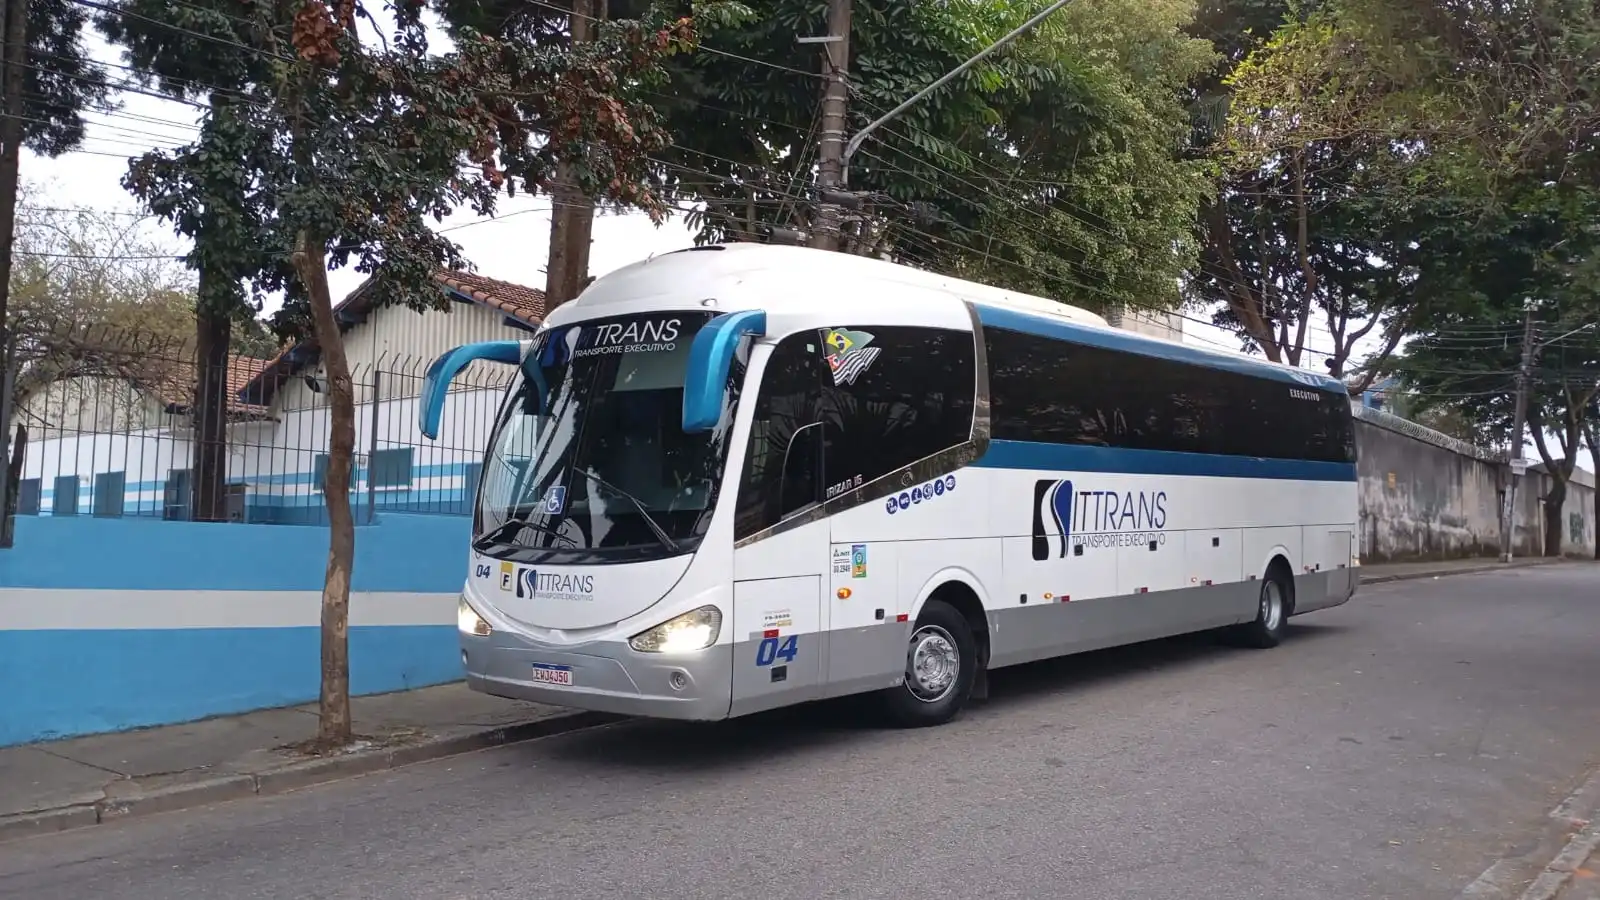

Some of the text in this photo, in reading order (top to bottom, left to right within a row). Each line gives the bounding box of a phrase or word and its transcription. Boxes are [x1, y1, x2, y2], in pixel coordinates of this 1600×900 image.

[575, 343, 676, 358] TRANSPORTE EXECUTIVO
[1289, 388, 1320, 402] EXECUTIVO
[826, 478, 852, 499] IRIZAR
[1072, 533, 1166, 548] TRANSPORTE EXECUTIVO
[476, 564, 491, 578] 04
[502, 574, 510, 587] F
[756, 635, 799, 667] 04
